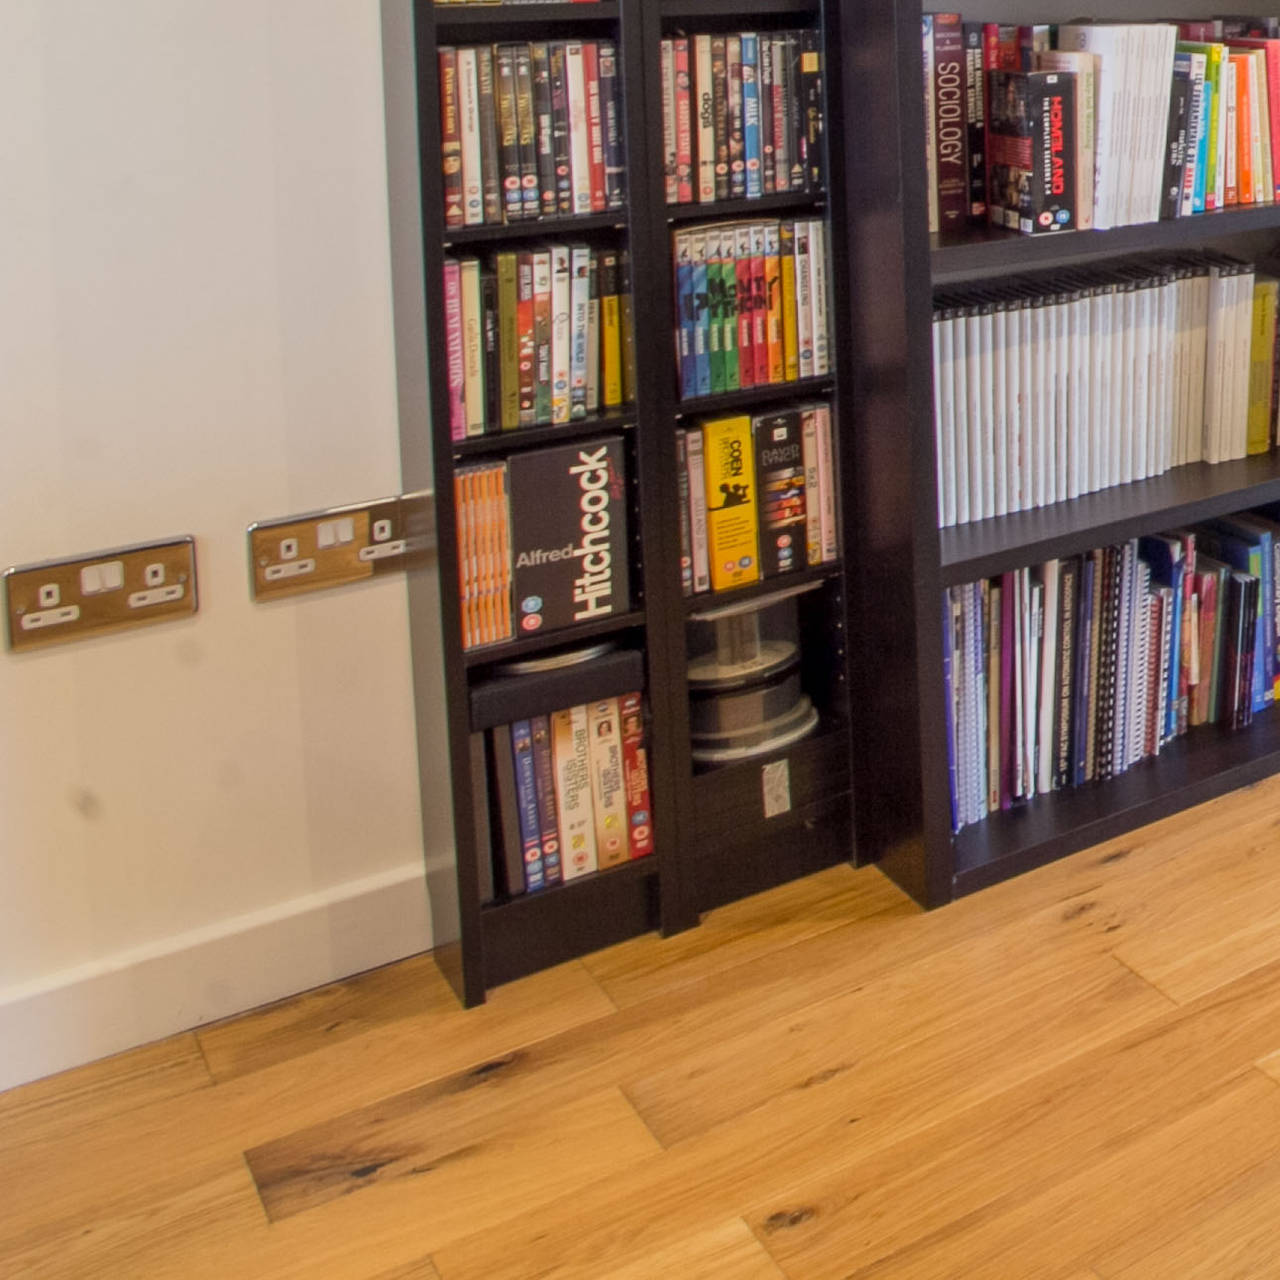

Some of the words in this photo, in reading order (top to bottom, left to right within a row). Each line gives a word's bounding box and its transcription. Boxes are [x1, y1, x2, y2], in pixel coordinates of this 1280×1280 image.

[966, 49, 974, 87] FINANCIAL
[745, 97, 758, 126] MILK
[937, 62, 963, 166] SOCIOLOGY
[1043, 113, 1051, 147] COMPLETE
[1051, 96, 1064, 195] HOMELAND
[576, 342, 584, 363] WILD
[730, 440, 742, 477] COEN
[569, 446, 612, 621] Hitchcock
[515, 544, 573, 568] Alfred
[575, 729, 588, 790] BROTHERS
[608, 745, 620, 792] BROTHERS
